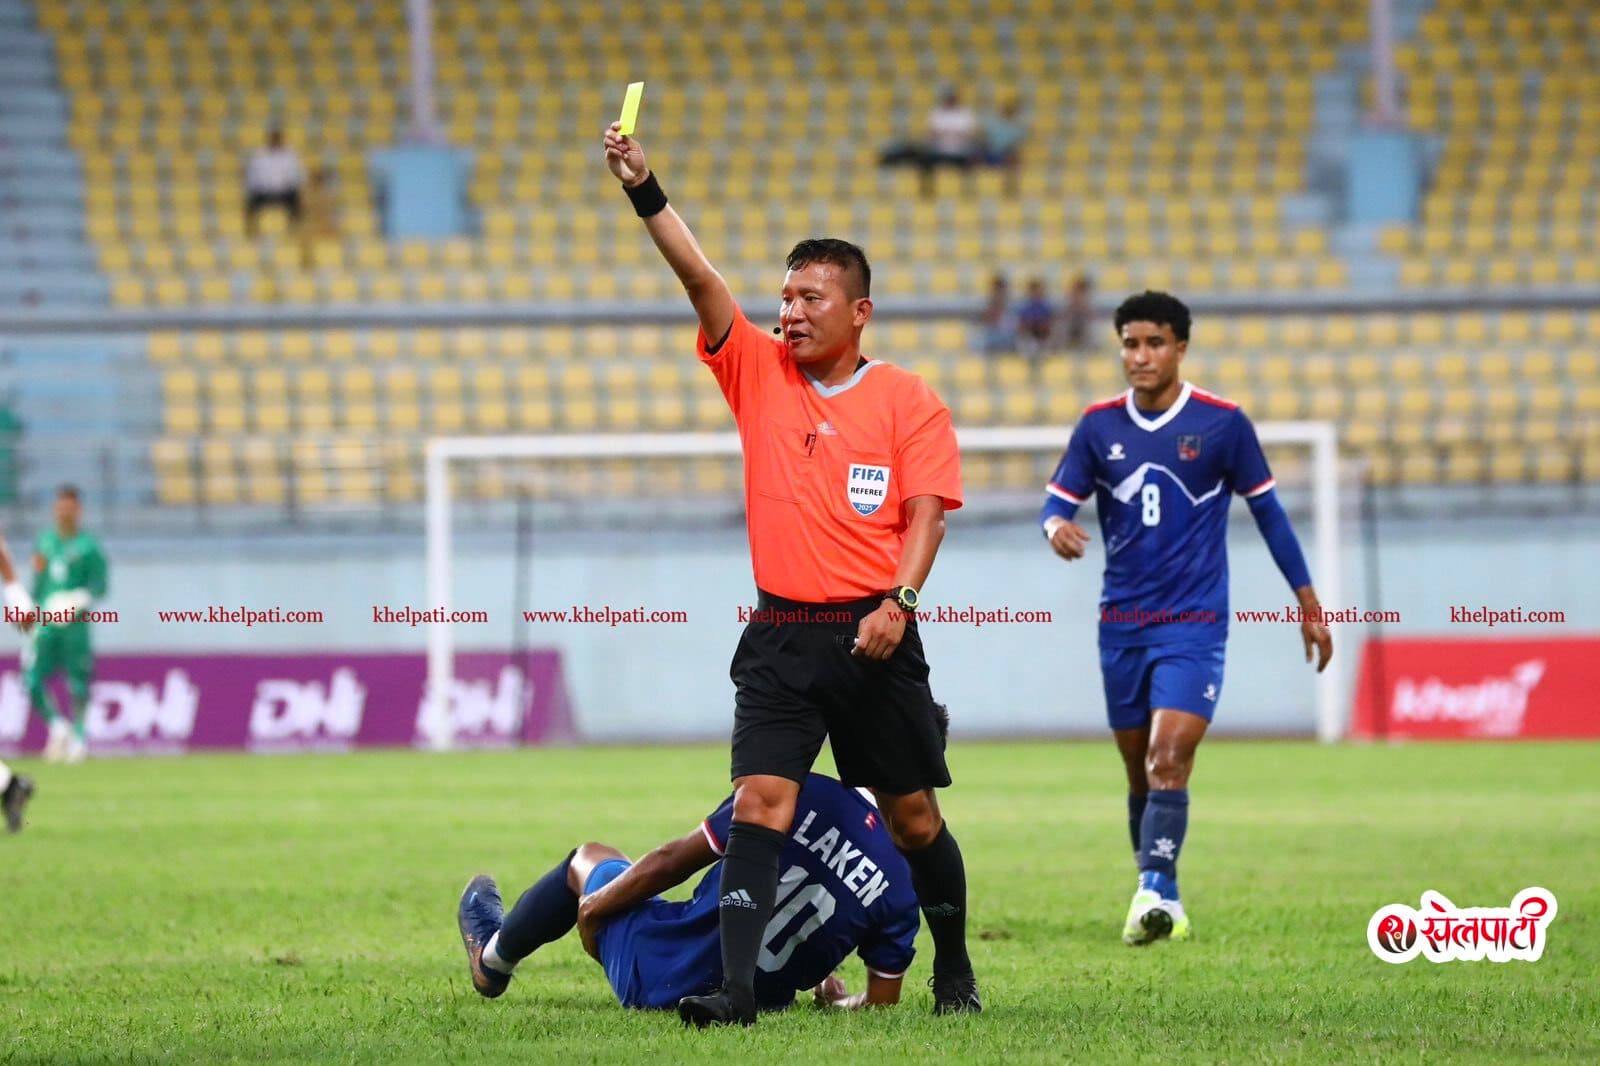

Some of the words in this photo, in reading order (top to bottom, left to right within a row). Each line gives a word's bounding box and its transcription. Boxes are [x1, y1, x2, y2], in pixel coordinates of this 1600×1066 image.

[852, 467, 885, 482] FIFA
[850, 486, 883, 497] REFEREE
[1141, 483, 1161, 527] 8
[793, 810, 890, 908] LAKEN
[719, 898, 758, 910] adidas
